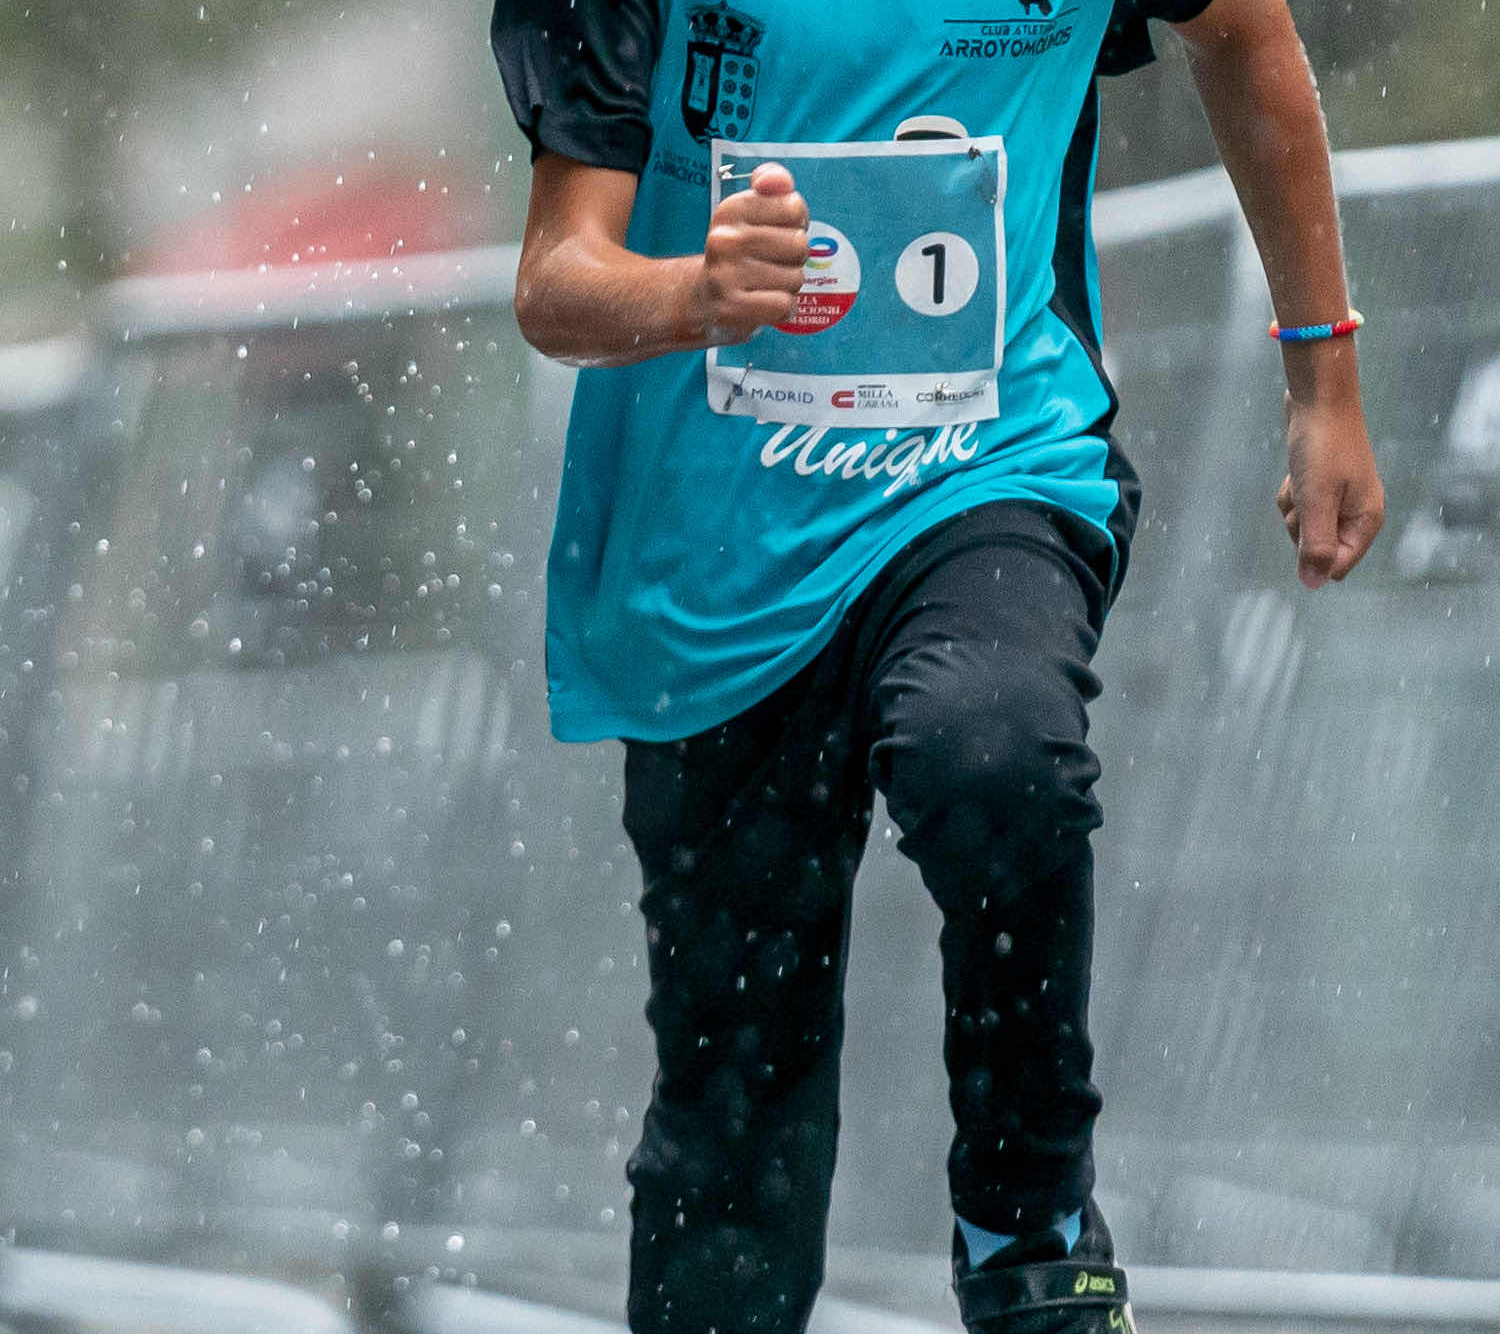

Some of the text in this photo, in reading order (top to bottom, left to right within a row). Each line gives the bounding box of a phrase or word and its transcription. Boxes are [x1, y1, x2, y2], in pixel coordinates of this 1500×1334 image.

[981, 25, 1010, 36] CLUB
[921, 243, 946, 305] 1
[751, 388, 814, 404] MADRID
[857, 389, 894, 399] MILLA
